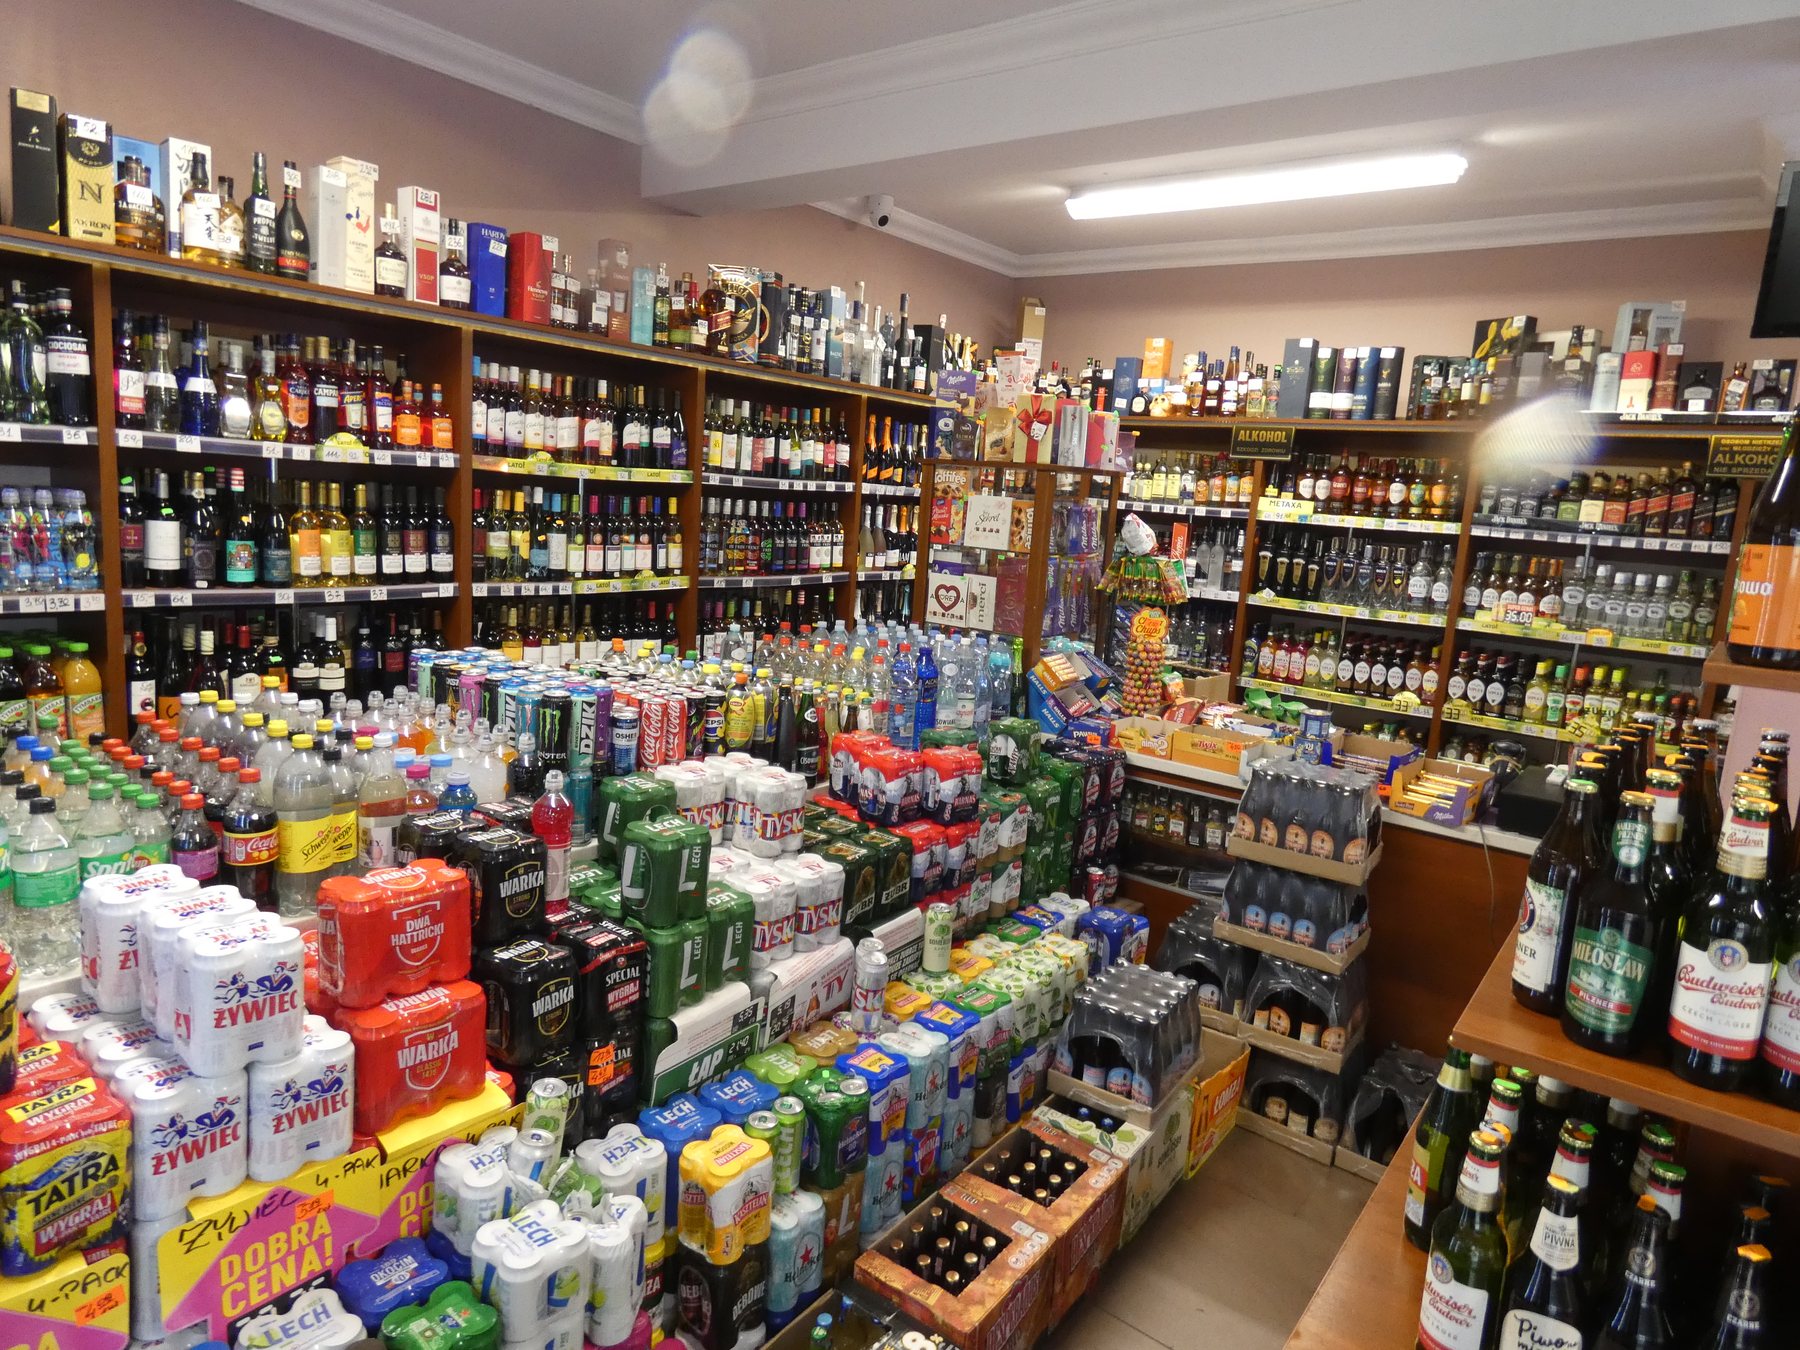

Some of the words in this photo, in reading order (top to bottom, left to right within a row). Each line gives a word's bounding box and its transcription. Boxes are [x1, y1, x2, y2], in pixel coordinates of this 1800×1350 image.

[78, 180, 103, 204] N
[481, 228, 507, 240] HARDY
[947, 375, 967, 385] Milka
[1238, 430, 1287, 443] ALKOHOL
[1713, 454, 1778, 465] ALKOHO
[1269, 500, 1302, 509] METAXA
[978, 582, 987, 623] merci
[1505, 610, 1533, 623] 35.00
[1030, 675, 1047, 695] HALLS
[1042, 708, 1059, 728] HALLS
[1053, 706, 1067, 721] HALLS
[579, 705, 597, 755] DZIK
[644, 817, 687, 833] LECH
[685, 804, 723, 828] TYSK
[765, 809, 804, 838] TYSK
[1434, 810, 1455, 820] Milka
[1726, 832, 1764, 847] Budvar
[691, 845, 702, 869] LECH
[361, 866, 426, 884] WARKA
[500, 870, 544, 898] WARKA
[406, 914, 430, 932] DWA
[800, 903, 842, 932] TYSK
[391, 923, 444, 947] HATTRICKI
[735, 921, 744, 944] LECH
[754, 920, 796, 950] TYSK
[494, 940, 544, 958] WARKA
[694, 935, 703, 960] LECH
[606, 966, 641, 986] SPECJAL
[1677, 963, 1767, 998] Budweiser
[213, 989, 298, 1029] ŻYWIEC
[383, 987, 451, 1012] WARKA
[532, 985, 574, 1018] WARKA
[1578, 989, 1615, 1010] PILZNER
[1711, 992, 1762, 1010] Budvar
[1682, 1005, 1713, 1024] CZECH
[397, 1031, 459, 1069] WARKA
[15, 1083, 88, 1114] TATRA
[716, 1078, 752, 1101] LECH
[27, 1094, 97, 1126] WYGRAJ
[272, 1088, 350, 1135] ŻYWIEC
[655, 1102, 696, 1125] LECH
[151, 1124, 242, 1177] ŻYWIEC
[602, 1136, 648, 1165] LECH
[26, 1153, 120, 1217] TATRA
[39, 1192, 112, 1244] WYGRAJ
[512, 1214, 558, 1248] LECH
[1543, 1231, 1575, 1249] PIWNA
[219, 1210, 333, 1287] DOBRA
[221, 1236, 334, 1319] CENA!
[371, 1255, 418, 1282] OKOCIM
[264, 1302, 334, 1345] LECH
[1428, 1297, 1473, 1328] Budvar
[1514, 1313, 1565, 1347] Piwo
